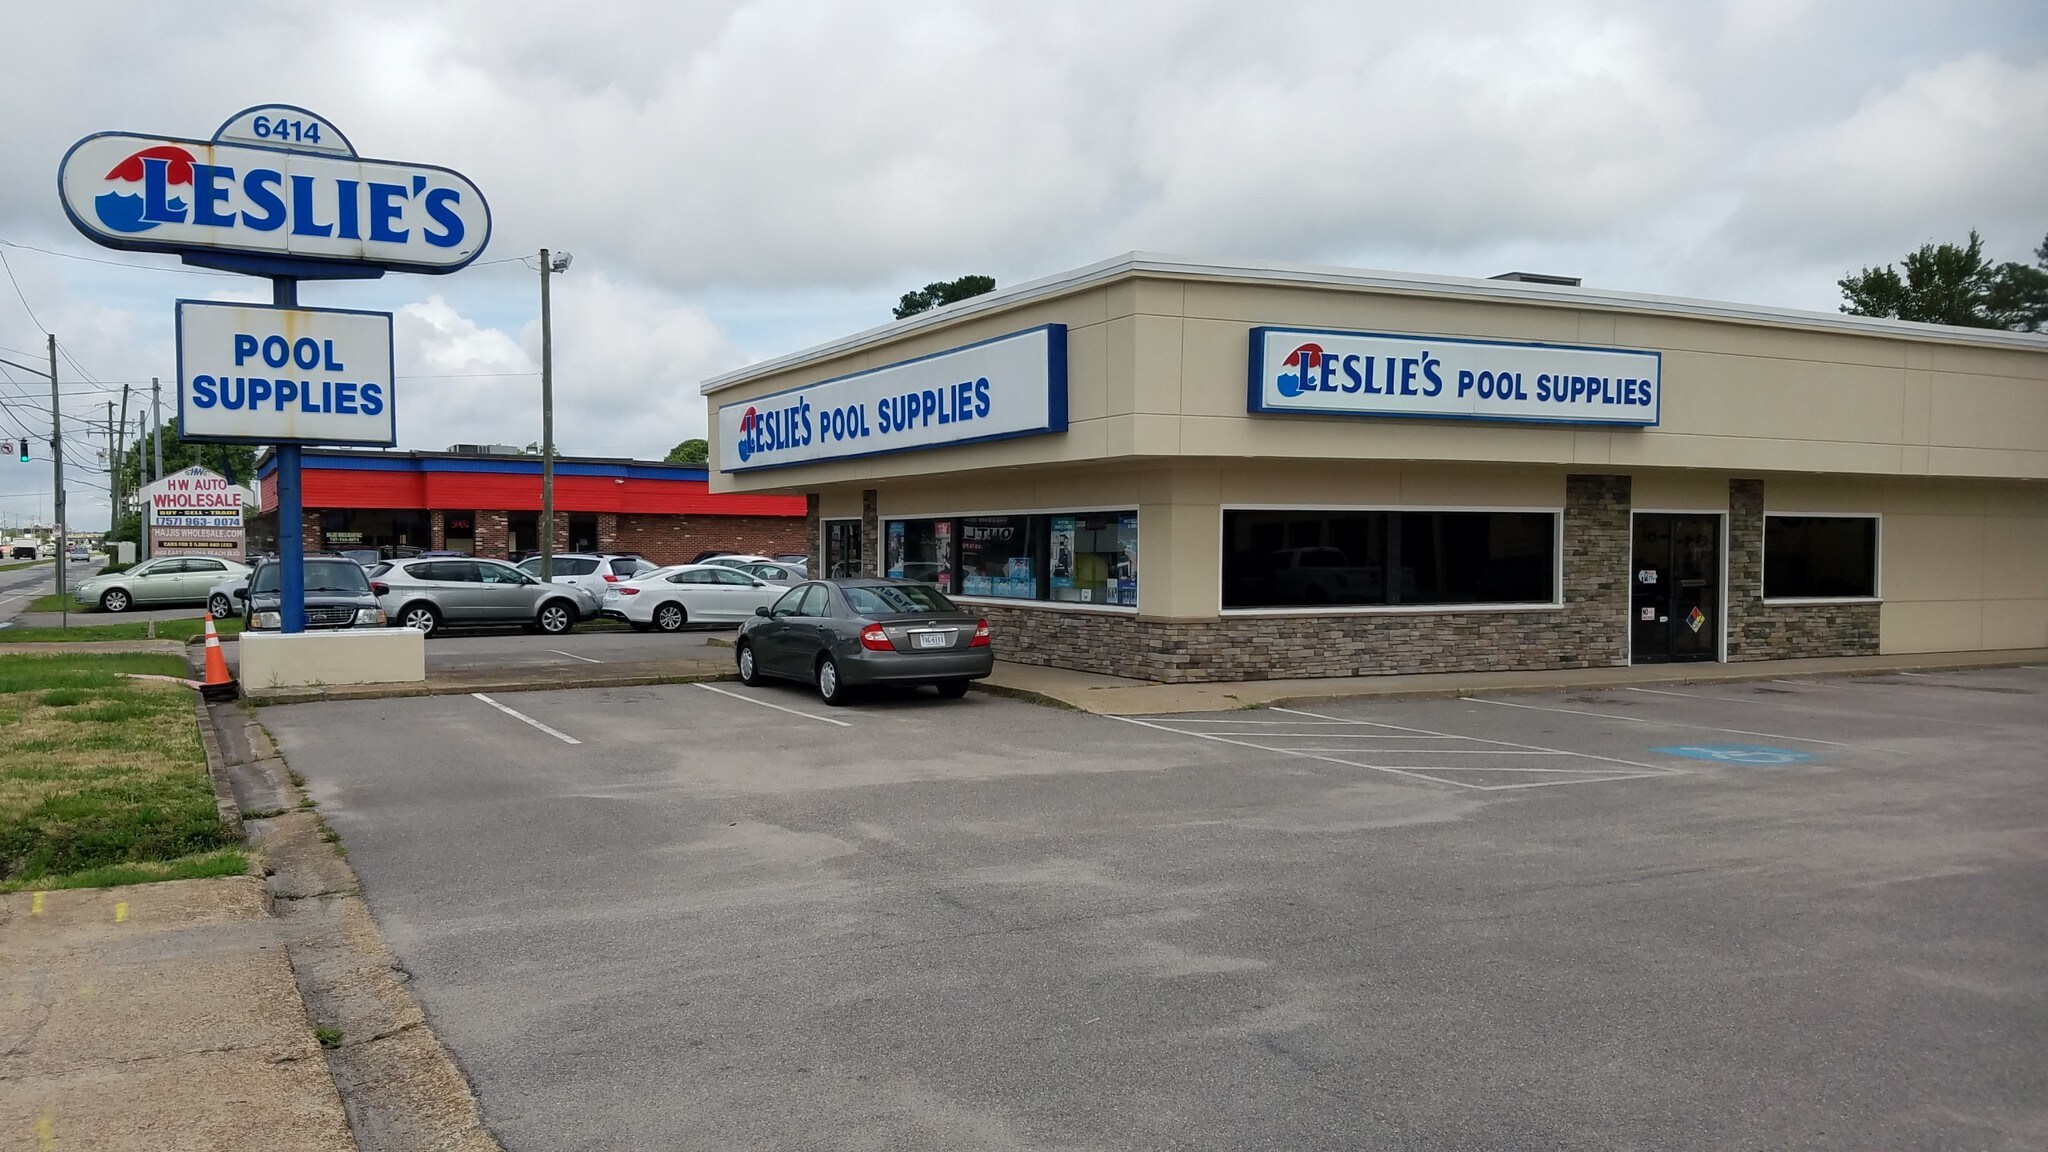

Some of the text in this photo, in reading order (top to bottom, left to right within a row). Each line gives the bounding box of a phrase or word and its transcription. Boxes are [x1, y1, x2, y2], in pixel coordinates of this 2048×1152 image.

[253, 115, 321, 144] 6414
[141, 158, 466, 249] LESLIE'S
[234, 333, 344, 372] POOL
[192, 374, 384, 416] SUPPLIES
[1297, 350, 1652, 407] LESLIE'S POOL SUPPLIES
[746, 377, 991, 455] LESLIE'S POOL SUPPLIES
[153, 493, 242, 508] WHOLESALE
[194, 479, 228, 491] AUTO
[156, 517, 183, 526] (757)
[213, 517, 241, 526] 0074
